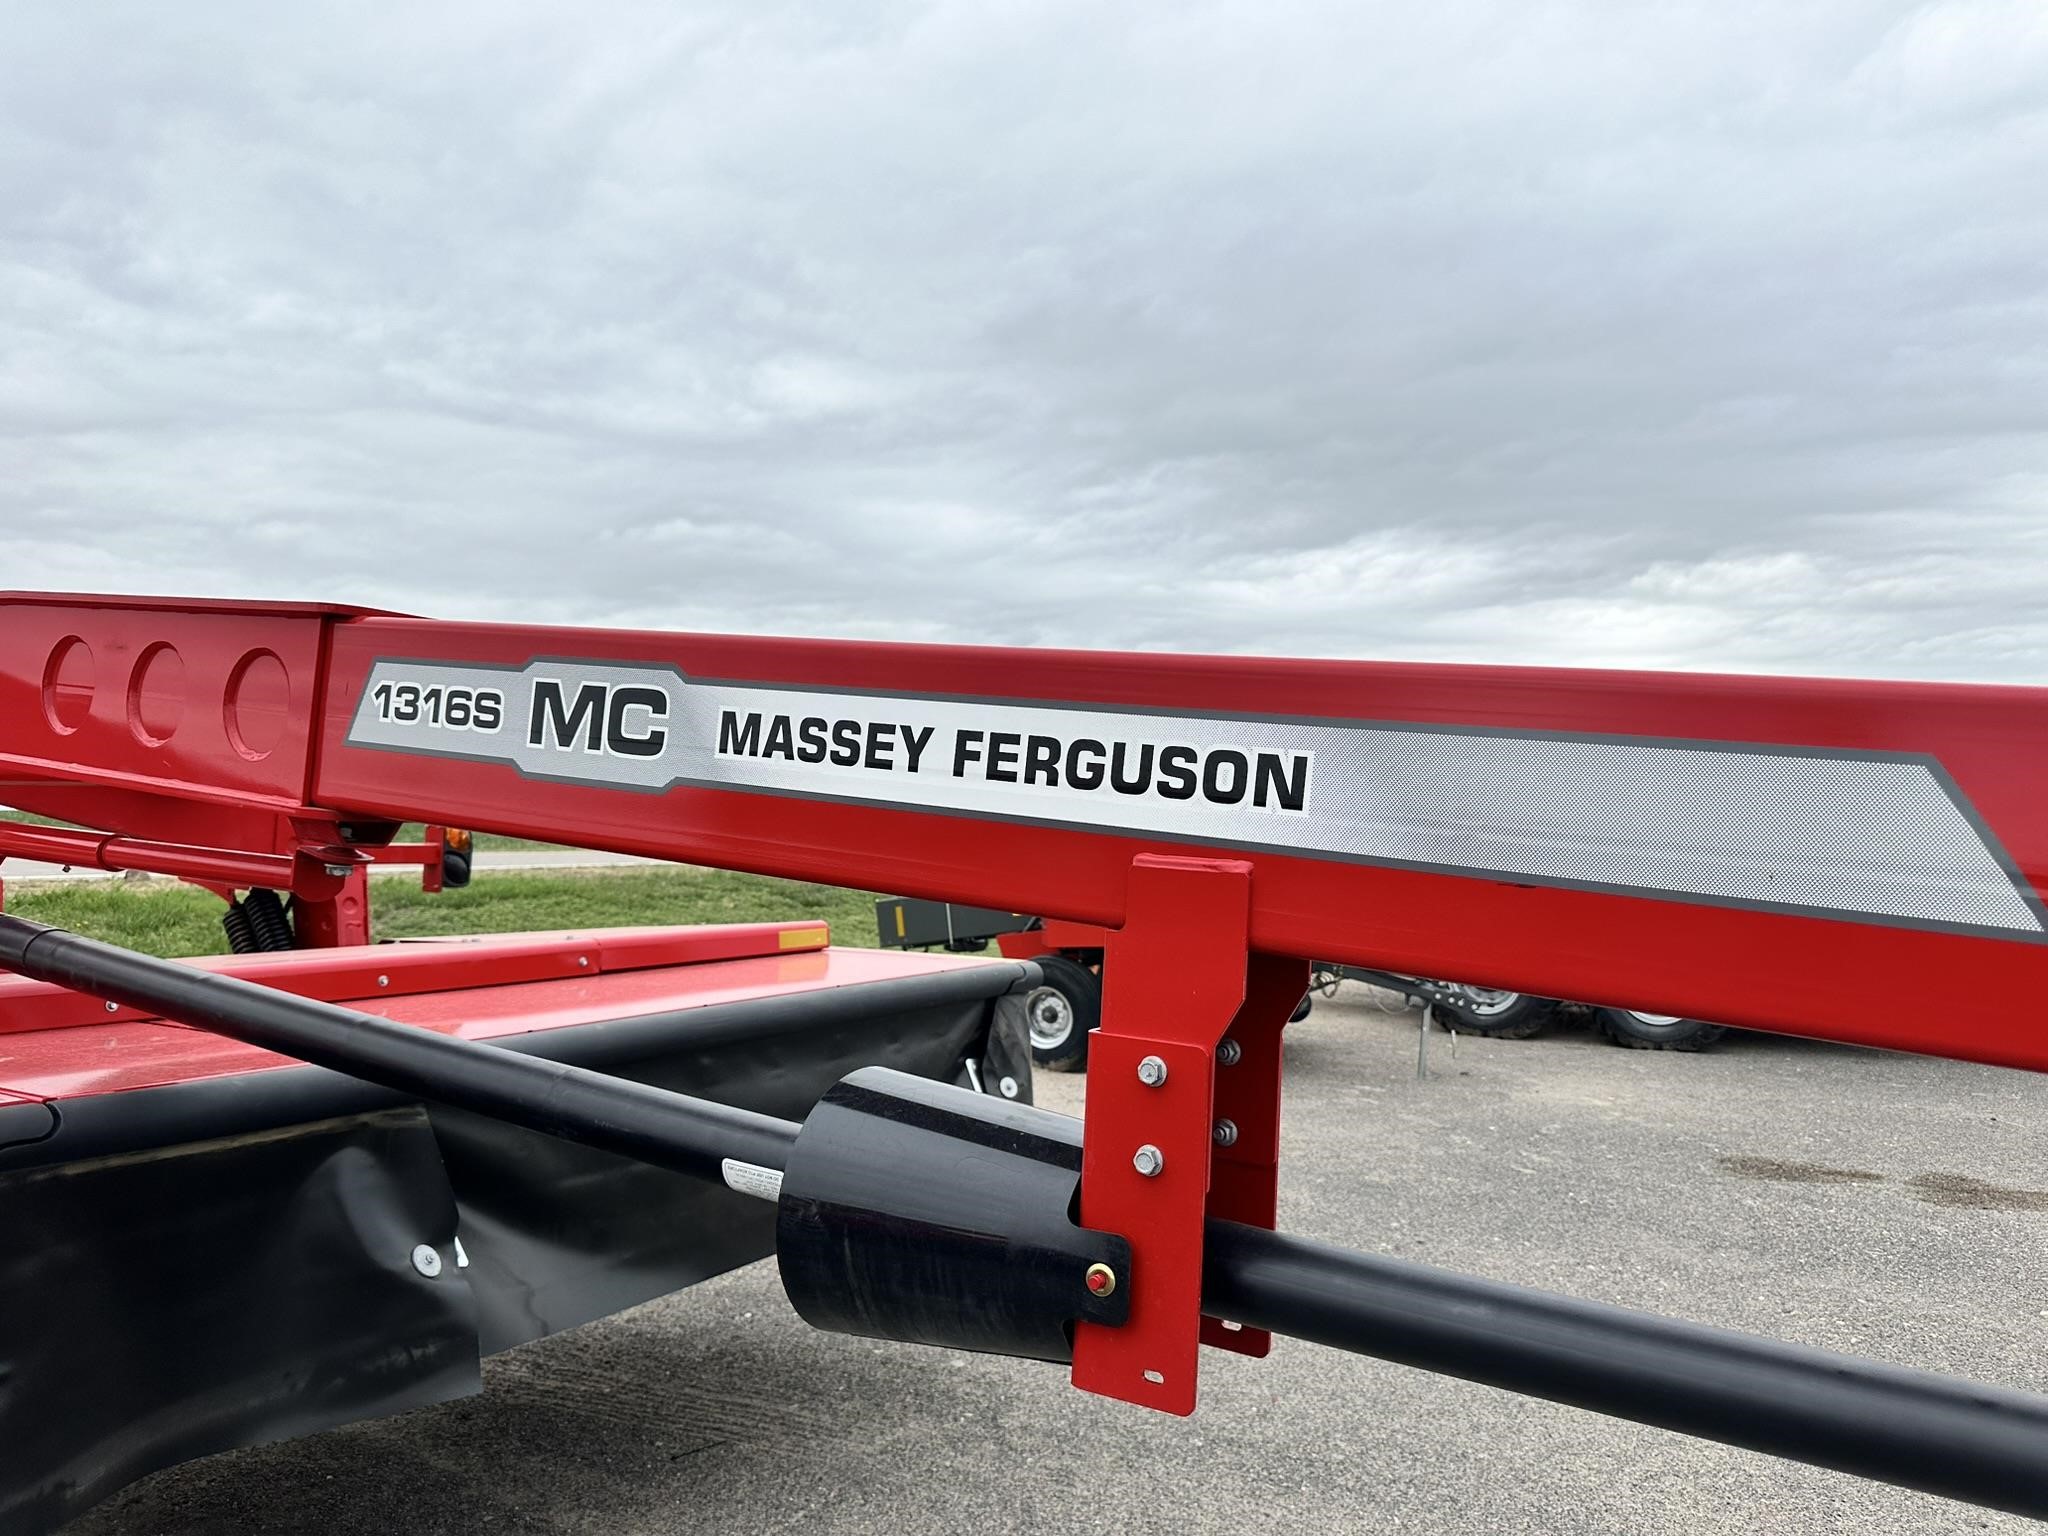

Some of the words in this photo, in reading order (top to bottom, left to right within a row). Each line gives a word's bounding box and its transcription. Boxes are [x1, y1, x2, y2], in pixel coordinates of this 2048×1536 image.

[373, 684, 502, 729] 1316S
[529, 681, 668, 757] MC
[718, 710, 935, 773] MASSEY
[951, 729, 1309, 812] FERGUSON
